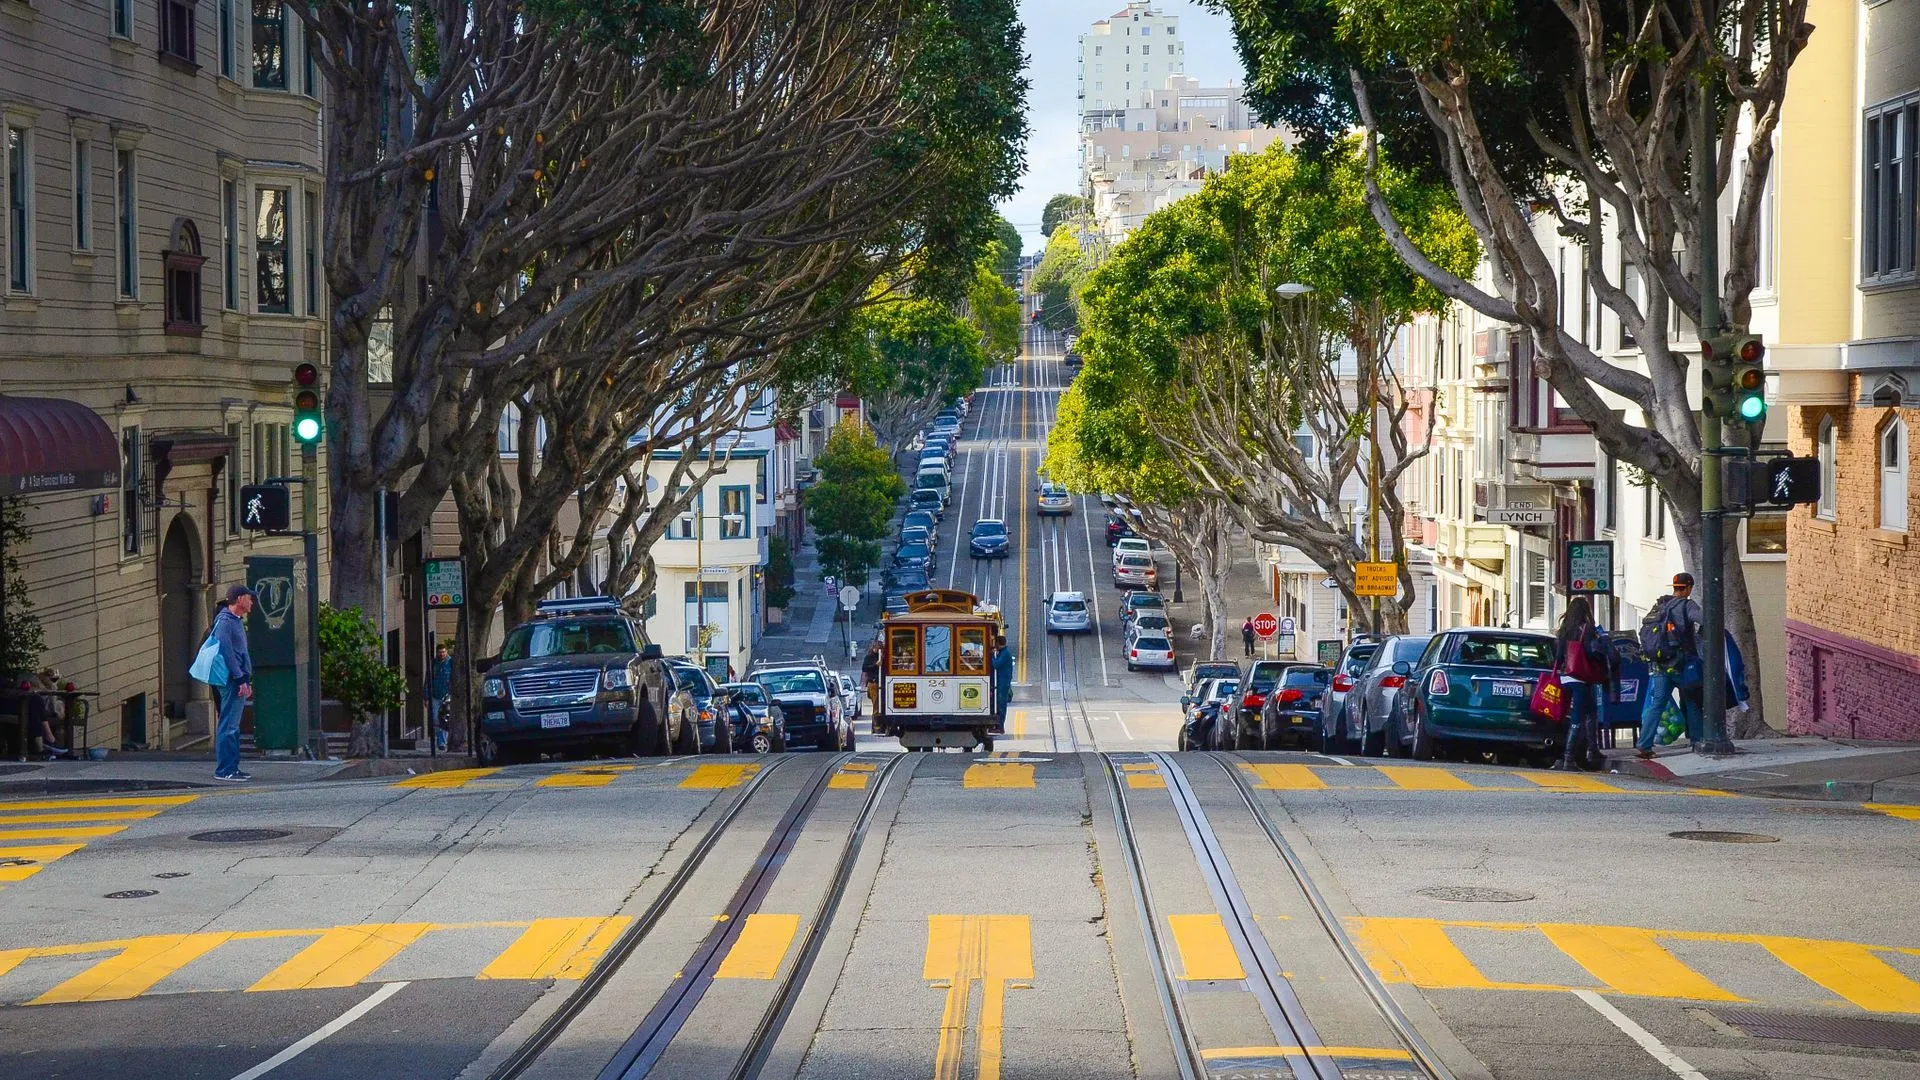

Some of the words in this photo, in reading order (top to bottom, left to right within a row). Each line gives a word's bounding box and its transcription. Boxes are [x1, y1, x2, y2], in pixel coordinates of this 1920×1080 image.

[33, 475, 41, 487] San
[1500, 512, 1542, 522] LYNCH
[1572, 546, 1581, 557] 2
[430, 563, 436, 573] 2
[1255, 620, 1276, 630] STOP
[928, 679, 946, 687] 24
